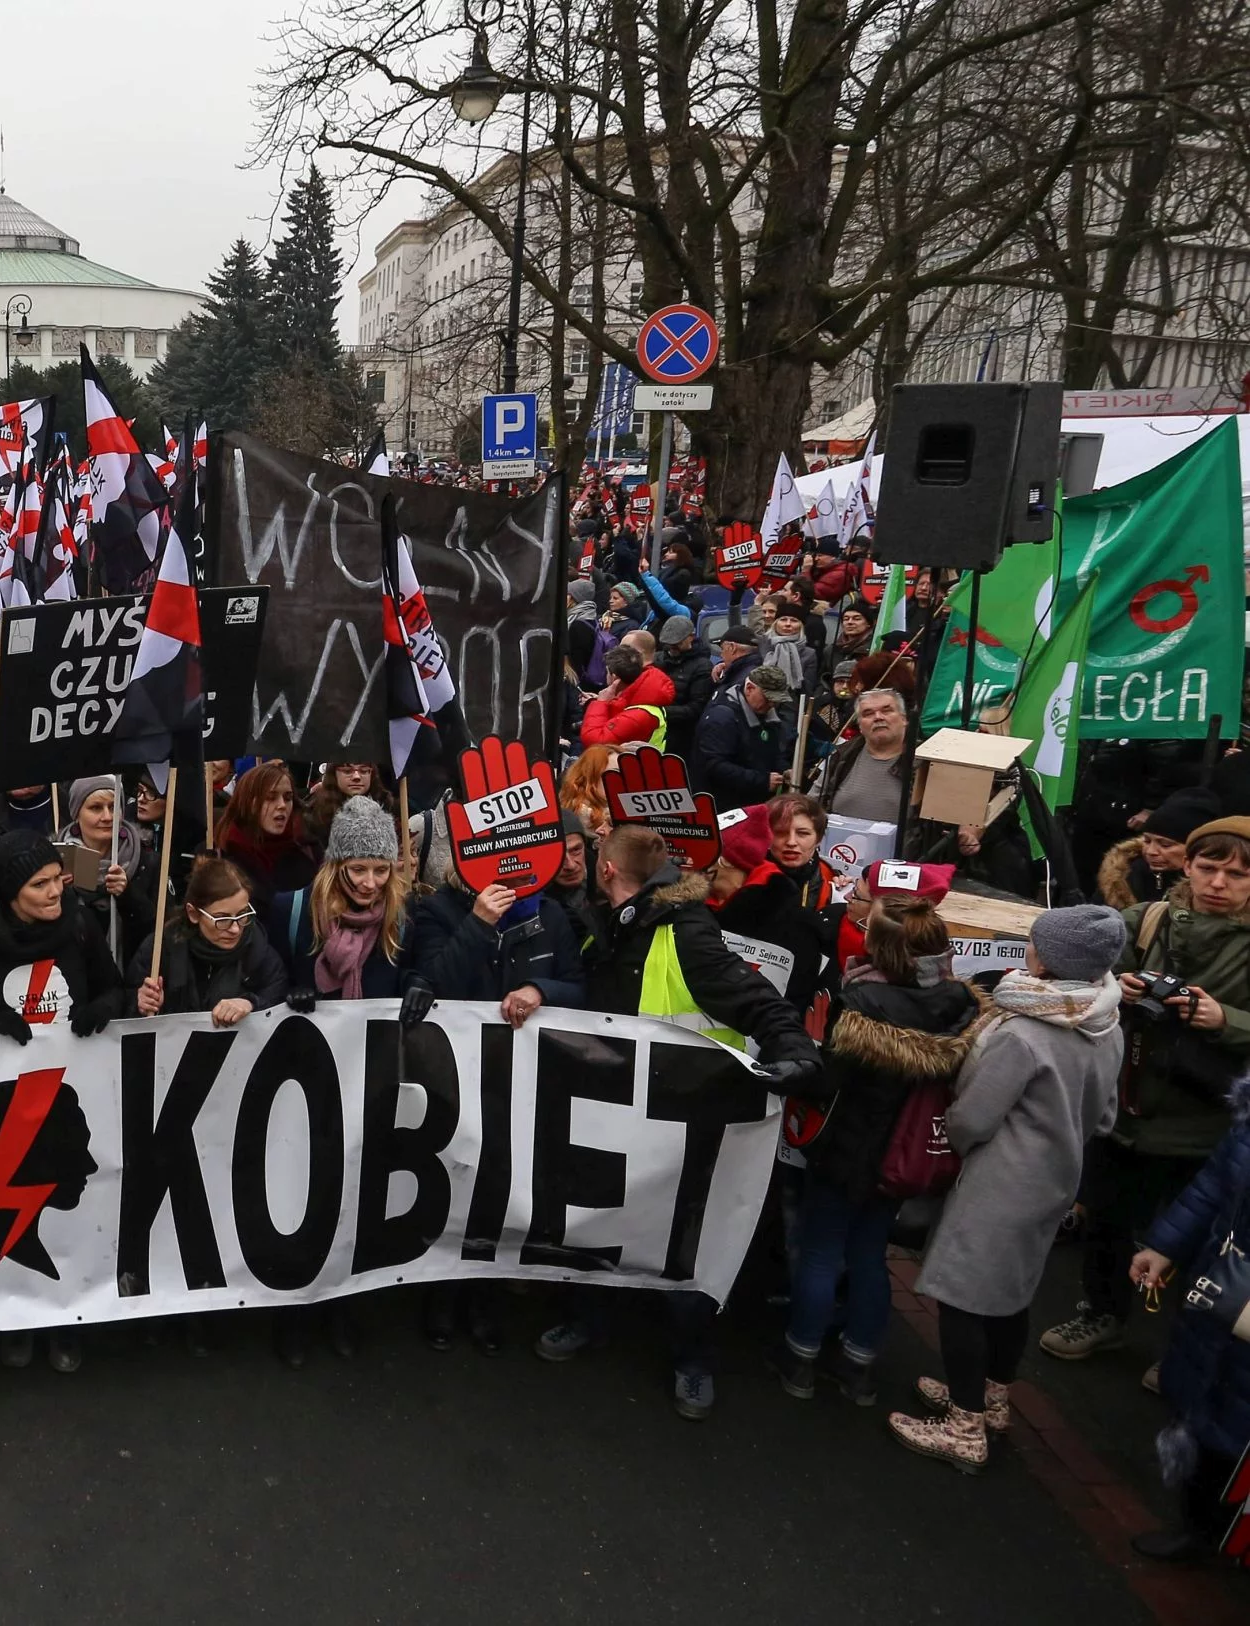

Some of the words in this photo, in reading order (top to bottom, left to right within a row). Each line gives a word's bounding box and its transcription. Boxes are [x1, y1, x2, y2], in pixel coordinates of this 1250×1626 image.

[670, 391, 697, 399] dotyczy
[496, 401, 525, 445] P
[636, 498, 650, 507] STOP
[729, 542, 753, 559] STOP
[770, 556, 792, 565] STOP
[62, 596, 147, 649] MYŚ
[50, 654, 133, 699] CZU
[251, 617, 553, 752] WYÓR
[29, 698, 126, 744] DECY
[478, 785, 534, 825] STOP
[631, 791, 683, 813] STOP
[495, 821, 531, 834] ZAOSTRZENIU
[648, 826, 709, 837] NTYABORCYJNEJ
[463, 842, 493, 856] USTAWY
[494, 828, 558, 850] ANTYABORCYJNEJ
[759, 949, 778, 961] Sejm
[779, 955, 790, 965] RP
[997, 946, 1025, 959] 16:00
[18, 990, 59, 1006] STRAJK
[116, 1015, 767, 1298] KOBIET
